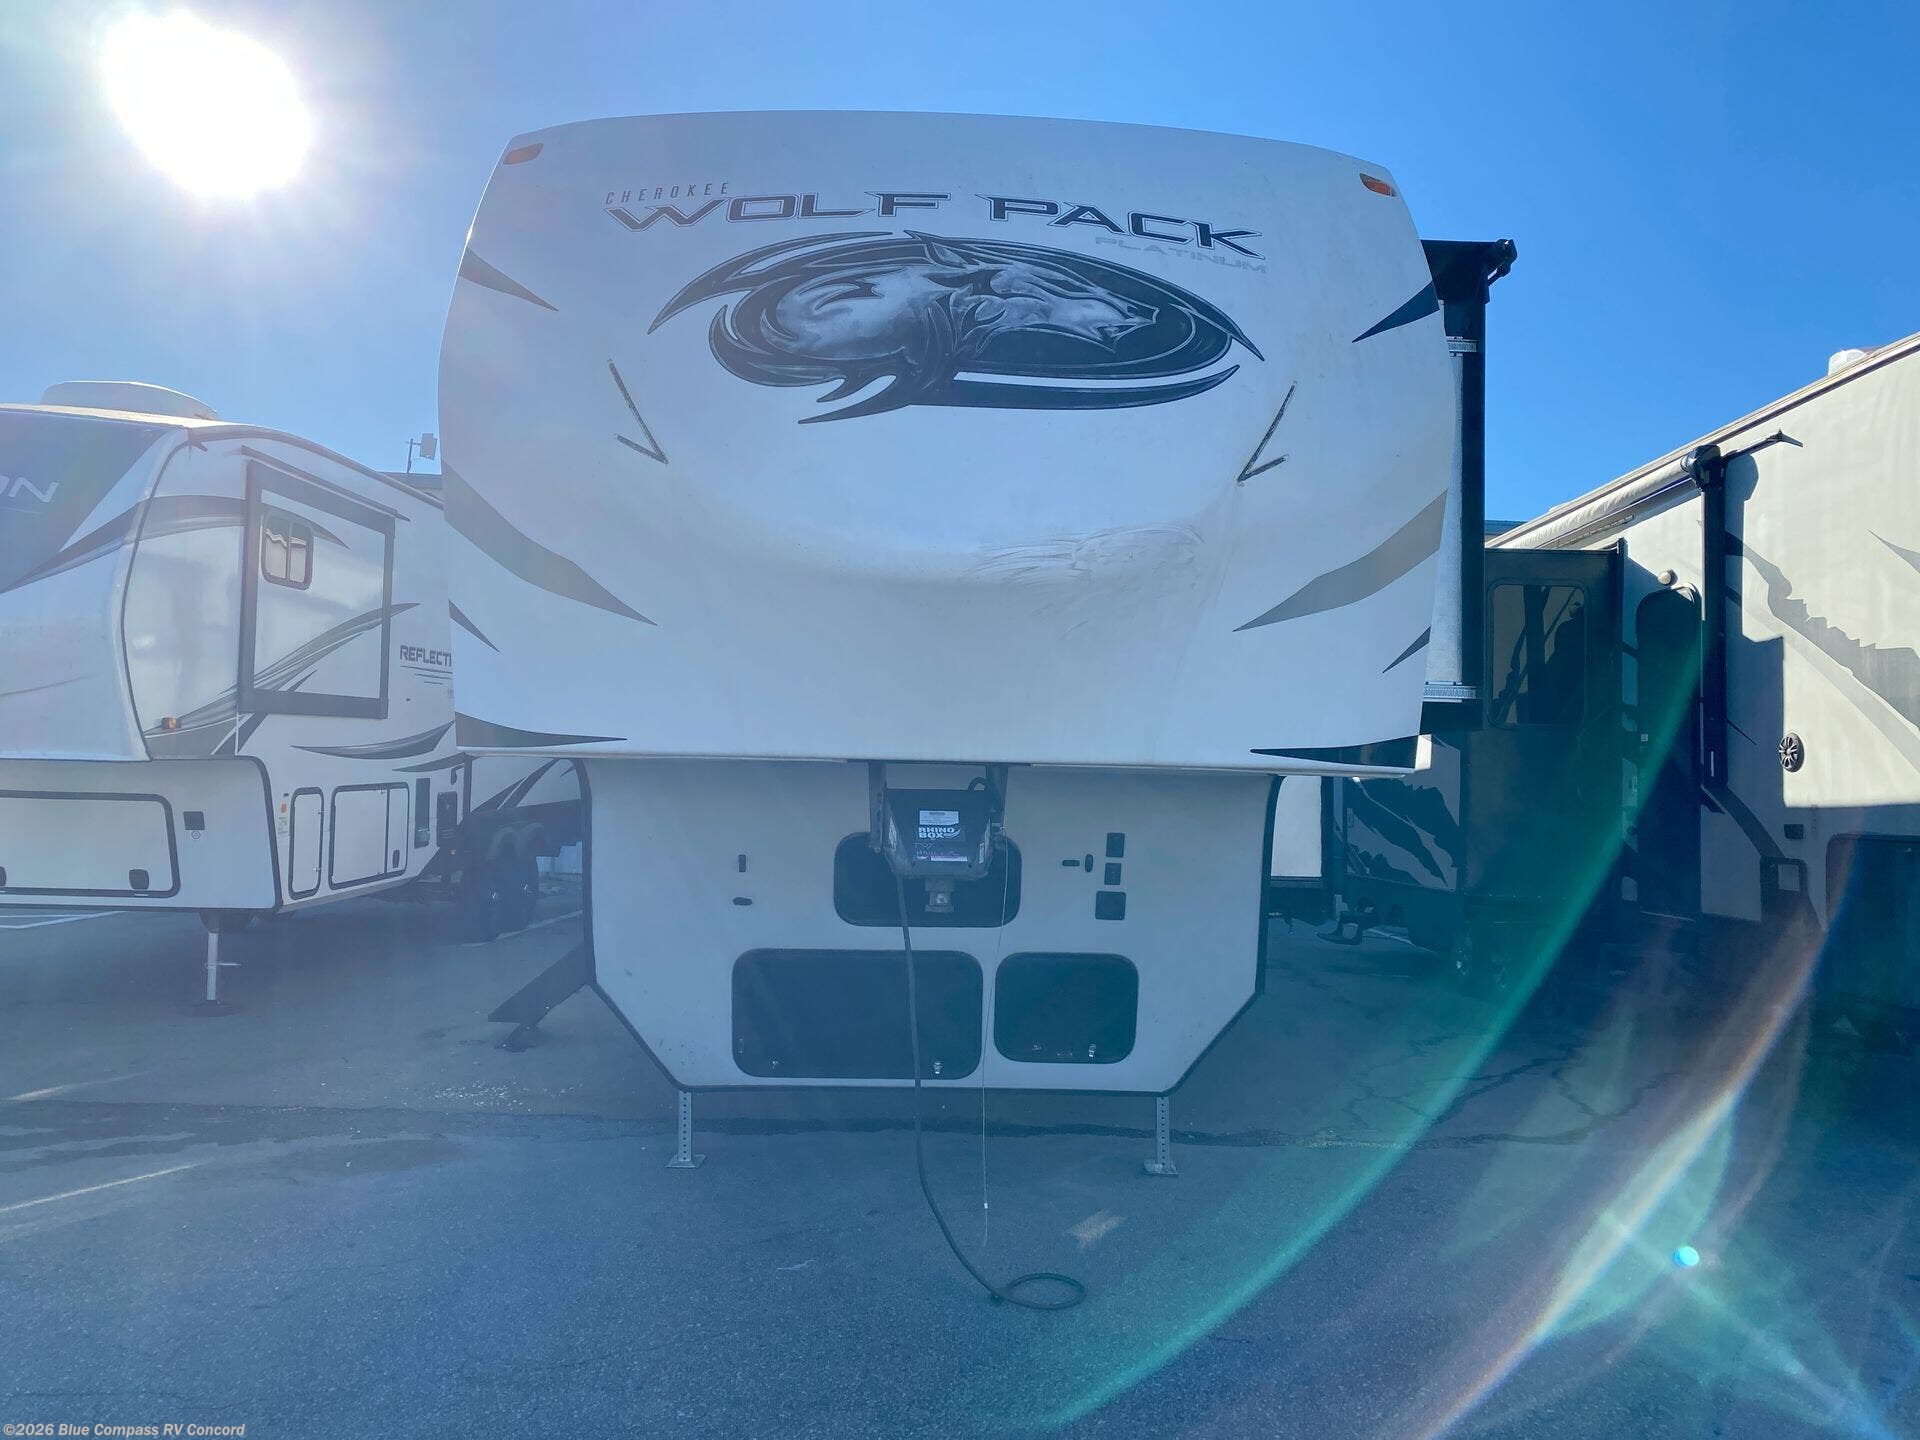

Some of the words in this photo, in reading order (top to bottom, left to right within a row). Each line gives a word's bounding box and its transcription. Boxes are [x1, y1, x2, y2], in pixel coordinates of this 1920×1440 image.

[605, 182, 731, 205] CHEROKEE
[603, 191, 950, 232] WOLF
[974, 192, 1266, 260] PACK
[1095, 236, 1267, 274] PLATINUM
